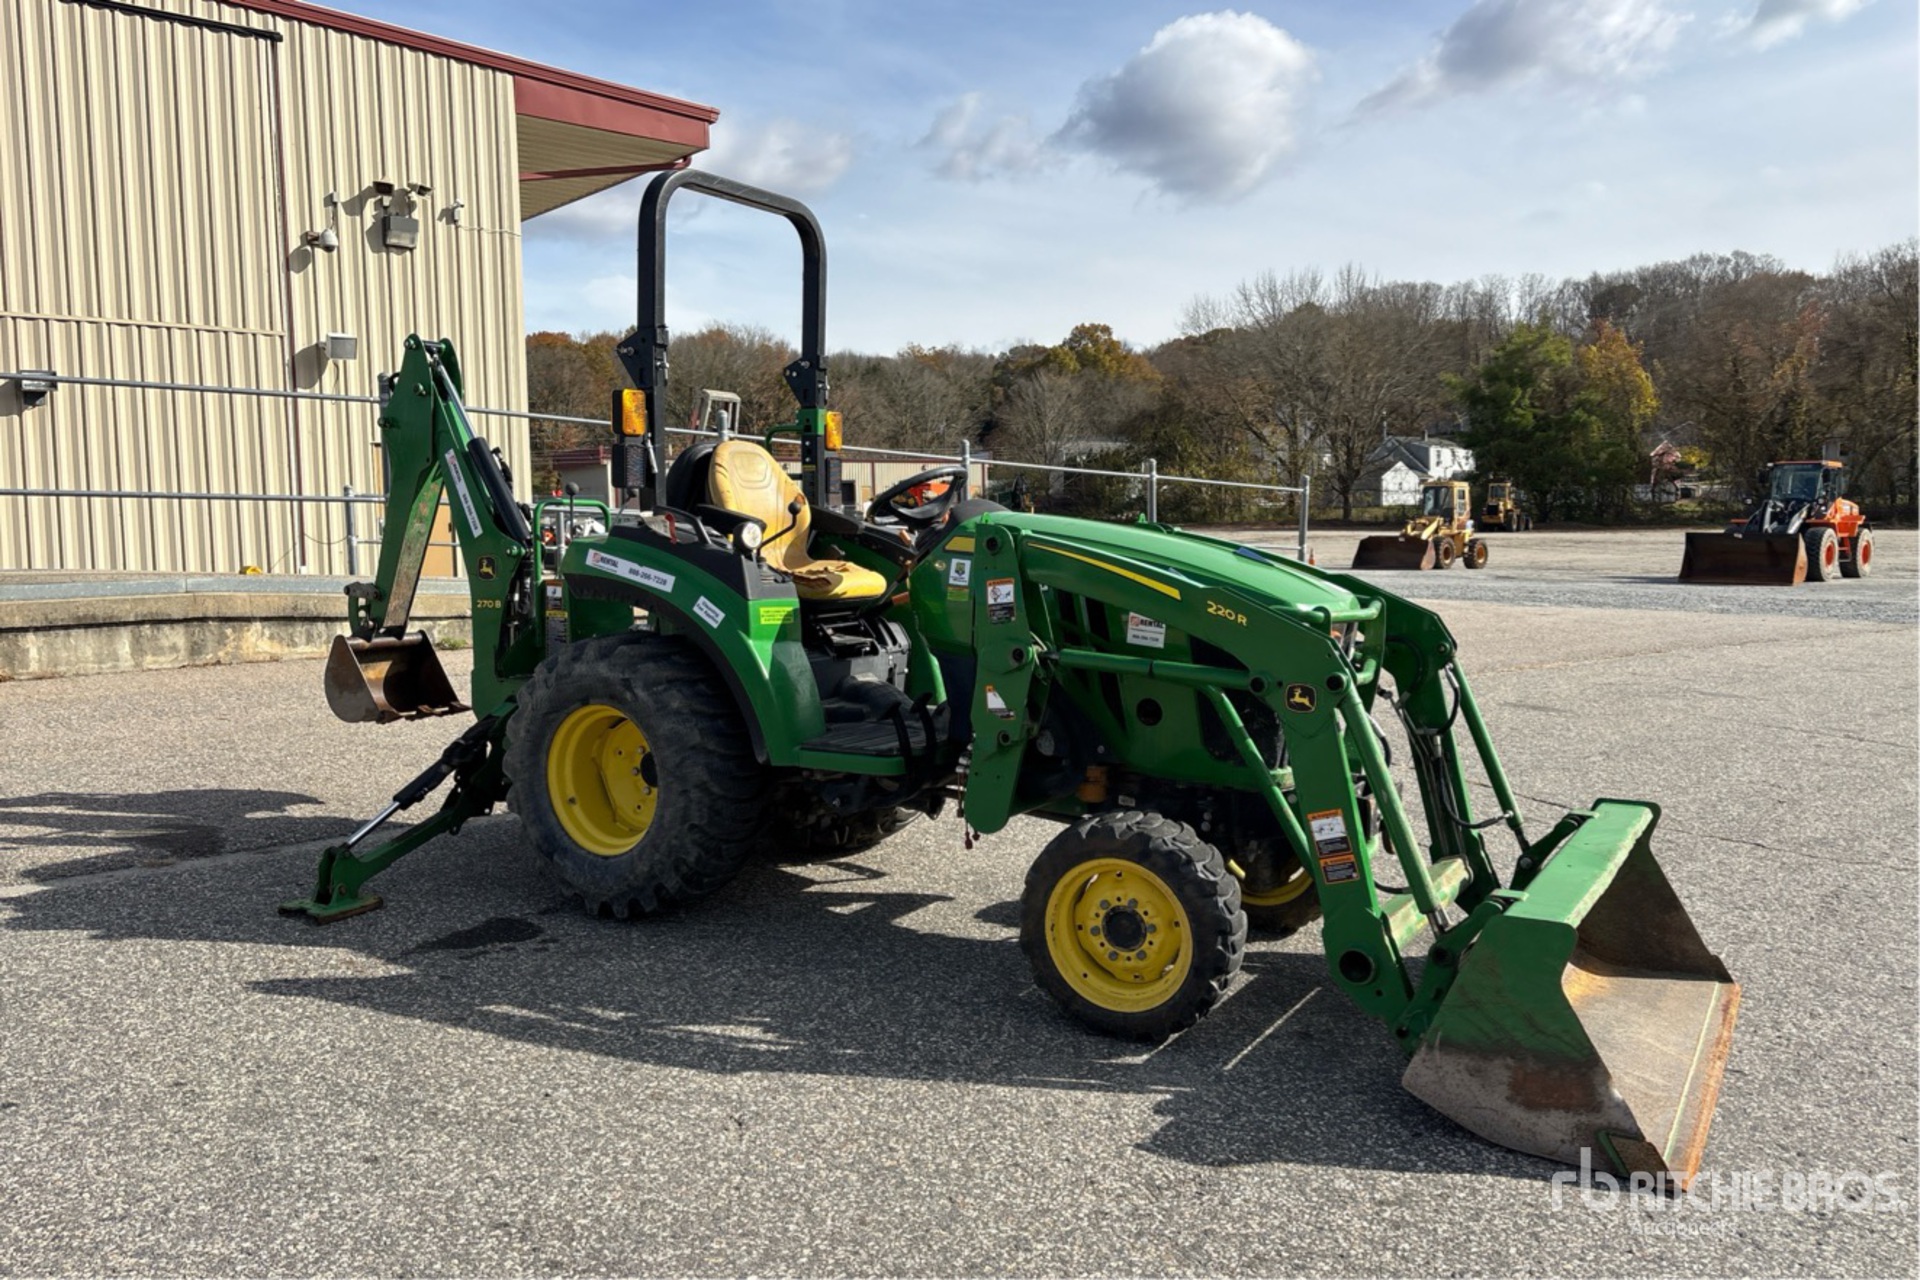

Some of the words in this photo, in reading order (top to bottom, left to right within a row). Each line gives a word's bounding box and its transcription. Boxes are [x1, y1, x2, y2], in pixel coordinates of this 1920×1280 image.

[476, 600, 493, 609] 270
[494, 600, 502, 608] B
[1206, 600, 1236, 621] 220
[1237, 613, 1248, 627] R
